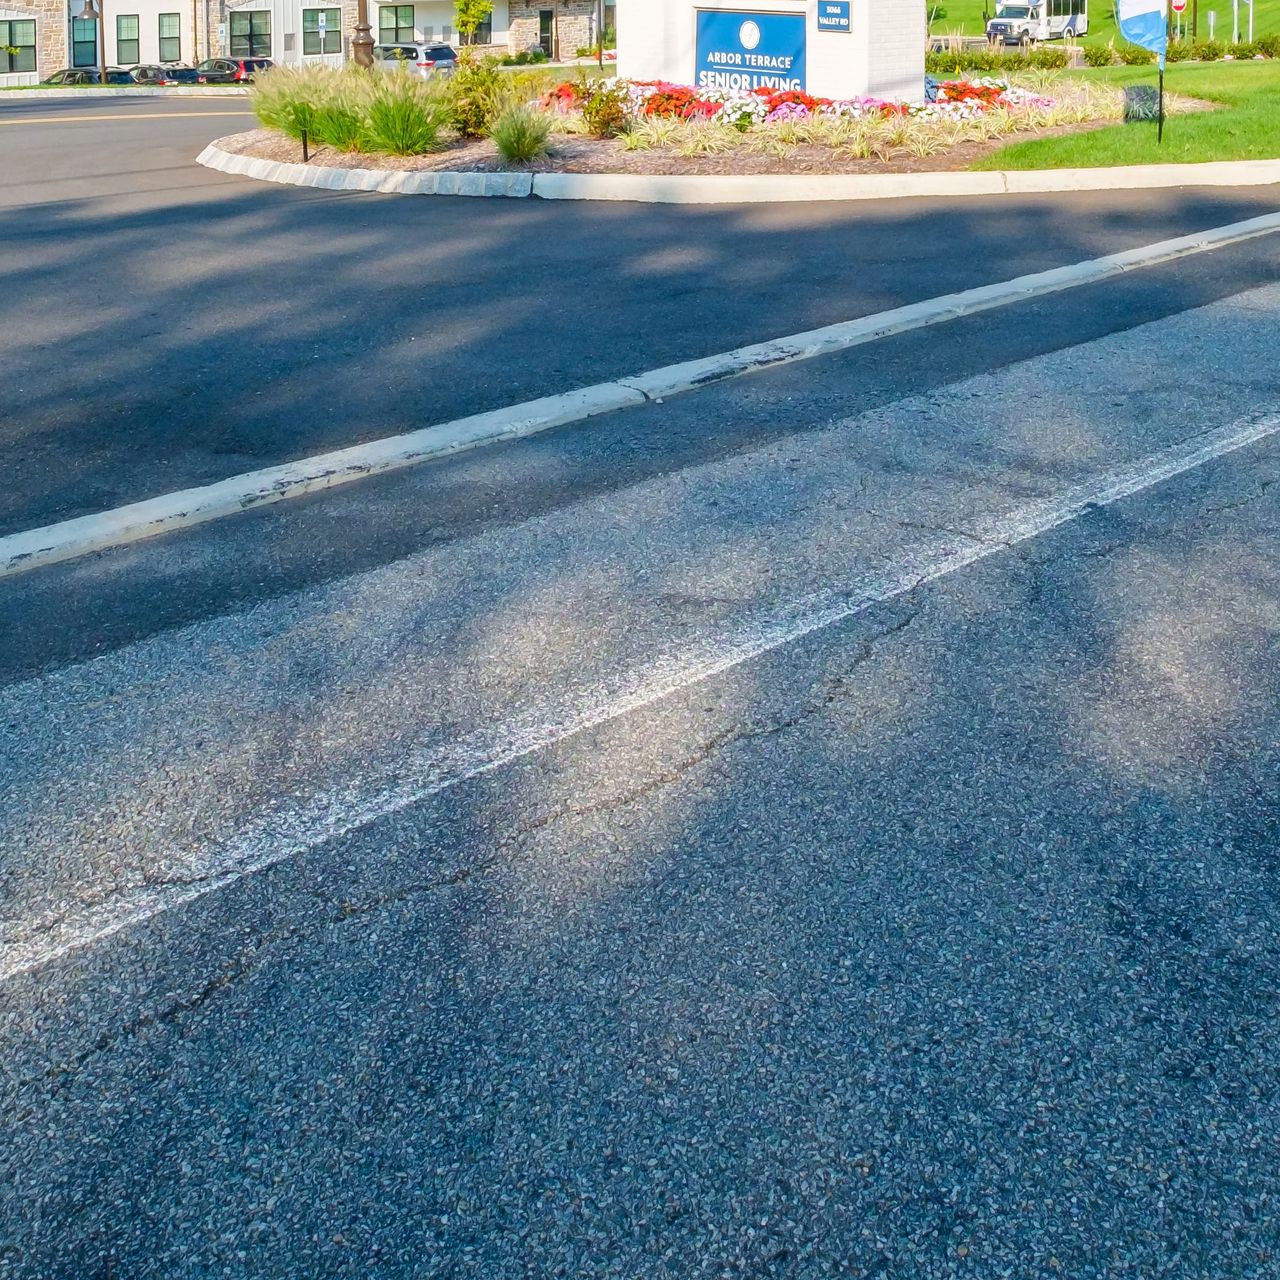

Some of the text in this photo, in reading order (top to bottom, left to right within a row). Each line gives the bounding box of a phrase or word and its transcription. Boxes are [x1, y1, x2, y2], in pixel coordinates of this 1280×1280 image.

[819, 16, 849, 26] VALLEY RD
[707, 52, 791, 69] ARBOR TERRACE
[699, 70, 801, 92] SENIOR LIVING
